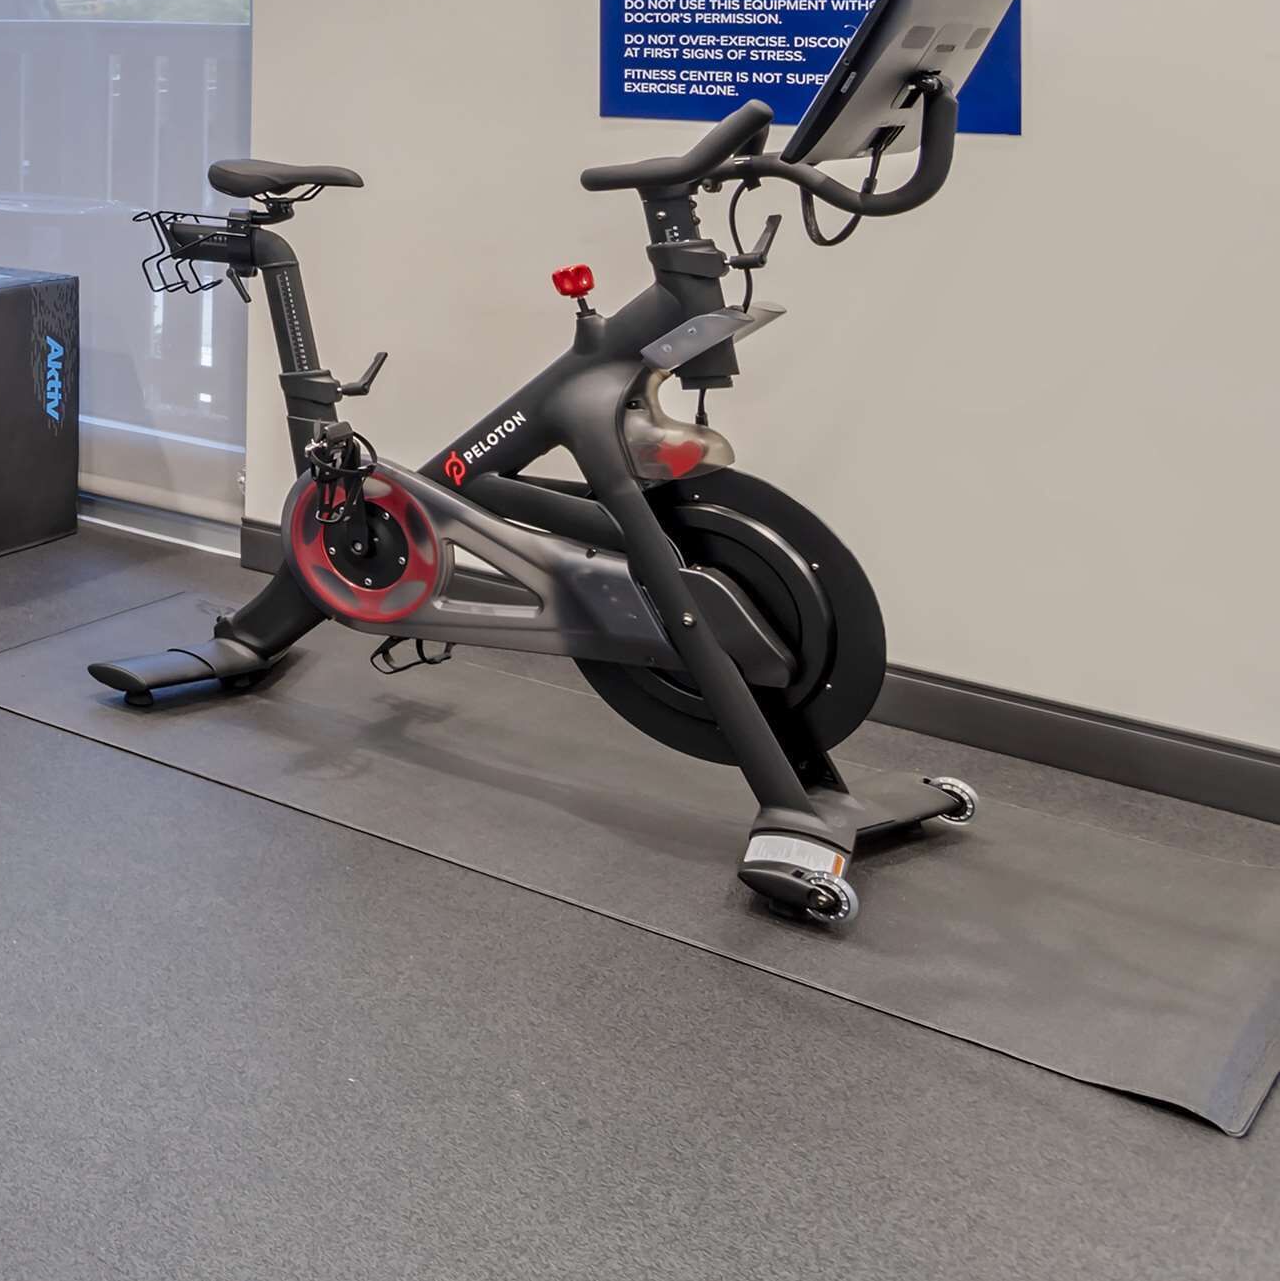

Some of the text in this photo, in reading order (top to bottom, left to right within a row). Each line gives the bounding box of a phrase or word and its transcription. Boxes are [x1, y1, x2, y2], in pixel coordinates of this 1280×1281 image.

[624, 0, 644, 10] DO
[648, 0, 676, 10] NOT
[679, 0, 706, 10] USE
[709, 0, 740, 10] THIS
[743, 0, 827, 11] EQUIPMENT
[624, 12, 782, 24] DOCTOR'S PERMISSION.
[624, 34, 850, 48] DO NOT OVER-EXERCISE. DISCON
[624, 47, 806, 62] AT FIRST SIGNS OF STRESS.
[624, 69, 676, 80] FITNESS
[679, 70, 732, 82] CENTER
[736, 72, 749, 83] IS
[752, 72, 782, 84] NOT
[624, 82, 739, 96] EXERCISE ALONE.
[45, 335, 65, 421] Aktiv
[463, 411, 527, 464] PELOTON
